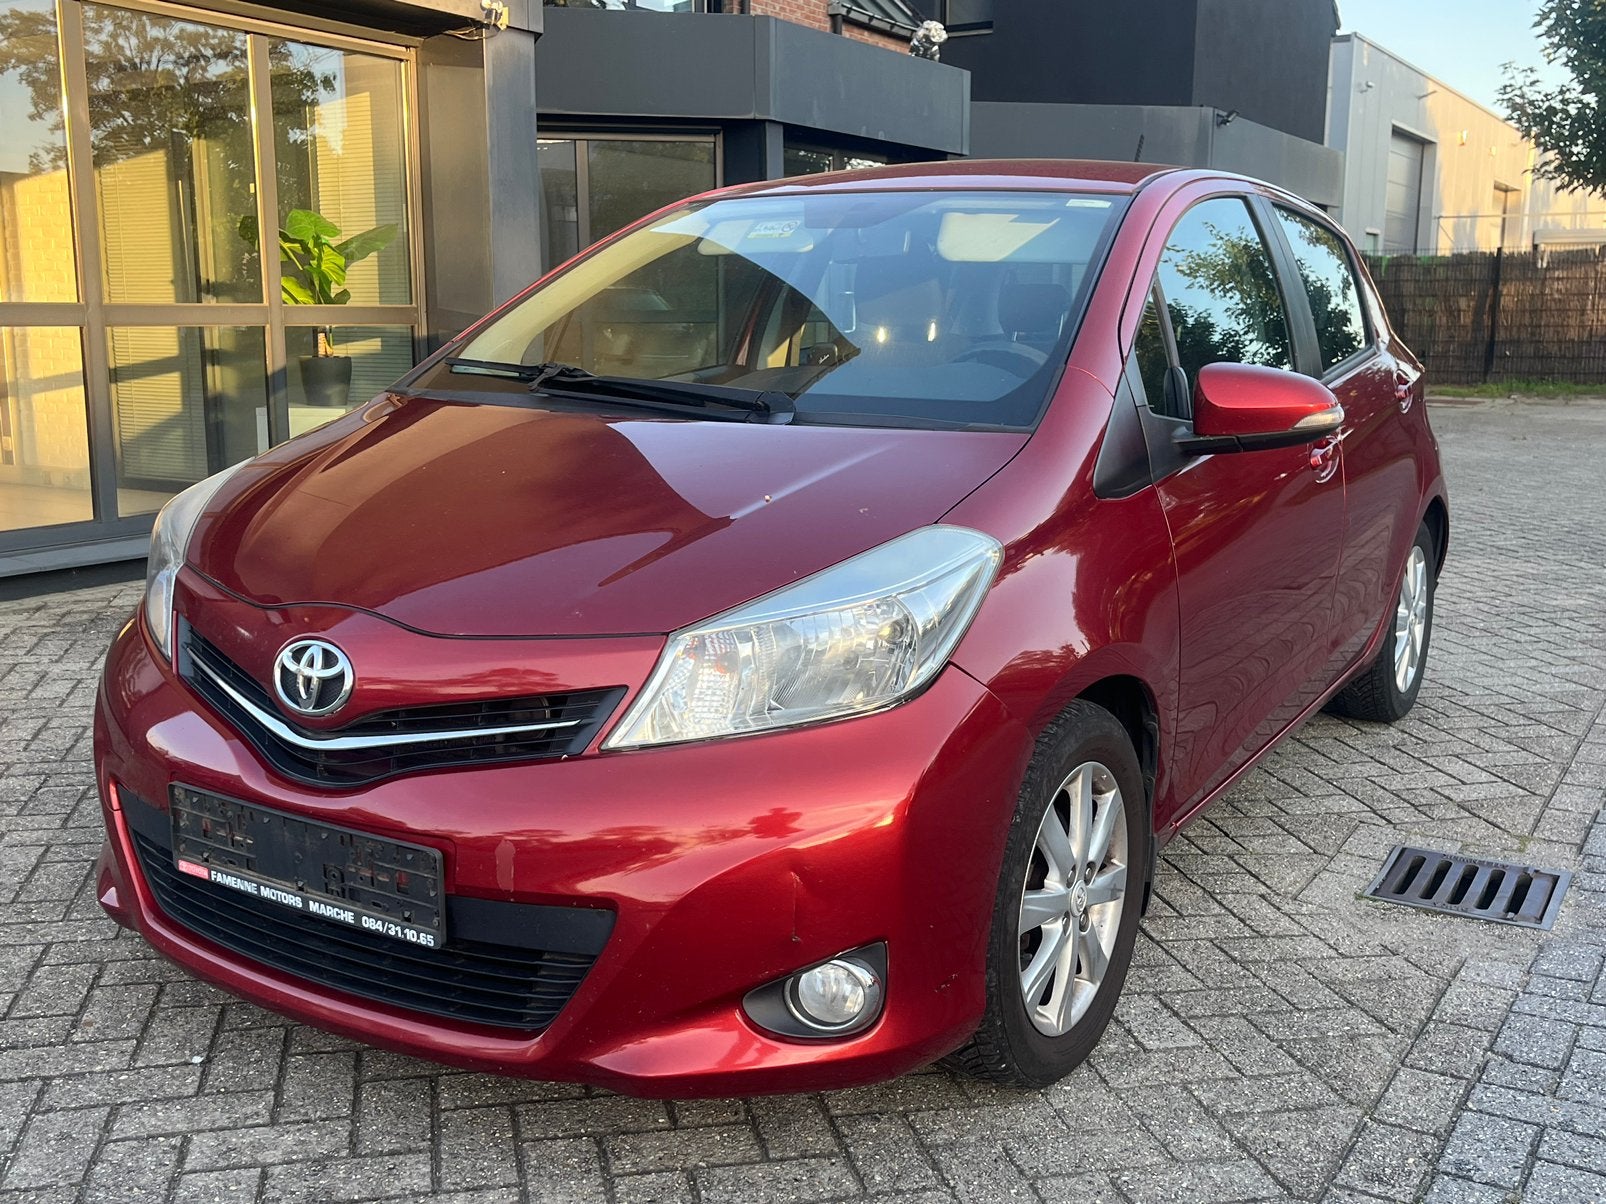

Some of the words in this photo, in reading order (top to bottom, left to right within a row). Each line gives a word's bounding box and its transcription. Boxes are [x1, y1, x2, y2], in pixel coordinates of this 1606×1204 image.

[211, 870, 258, 894] FAMENNE
[260, 885, 303, 908] MOTORS
[308, 900, 355, 924] MARCHE
[361, 915, 434, 947] 084/31.10.65
